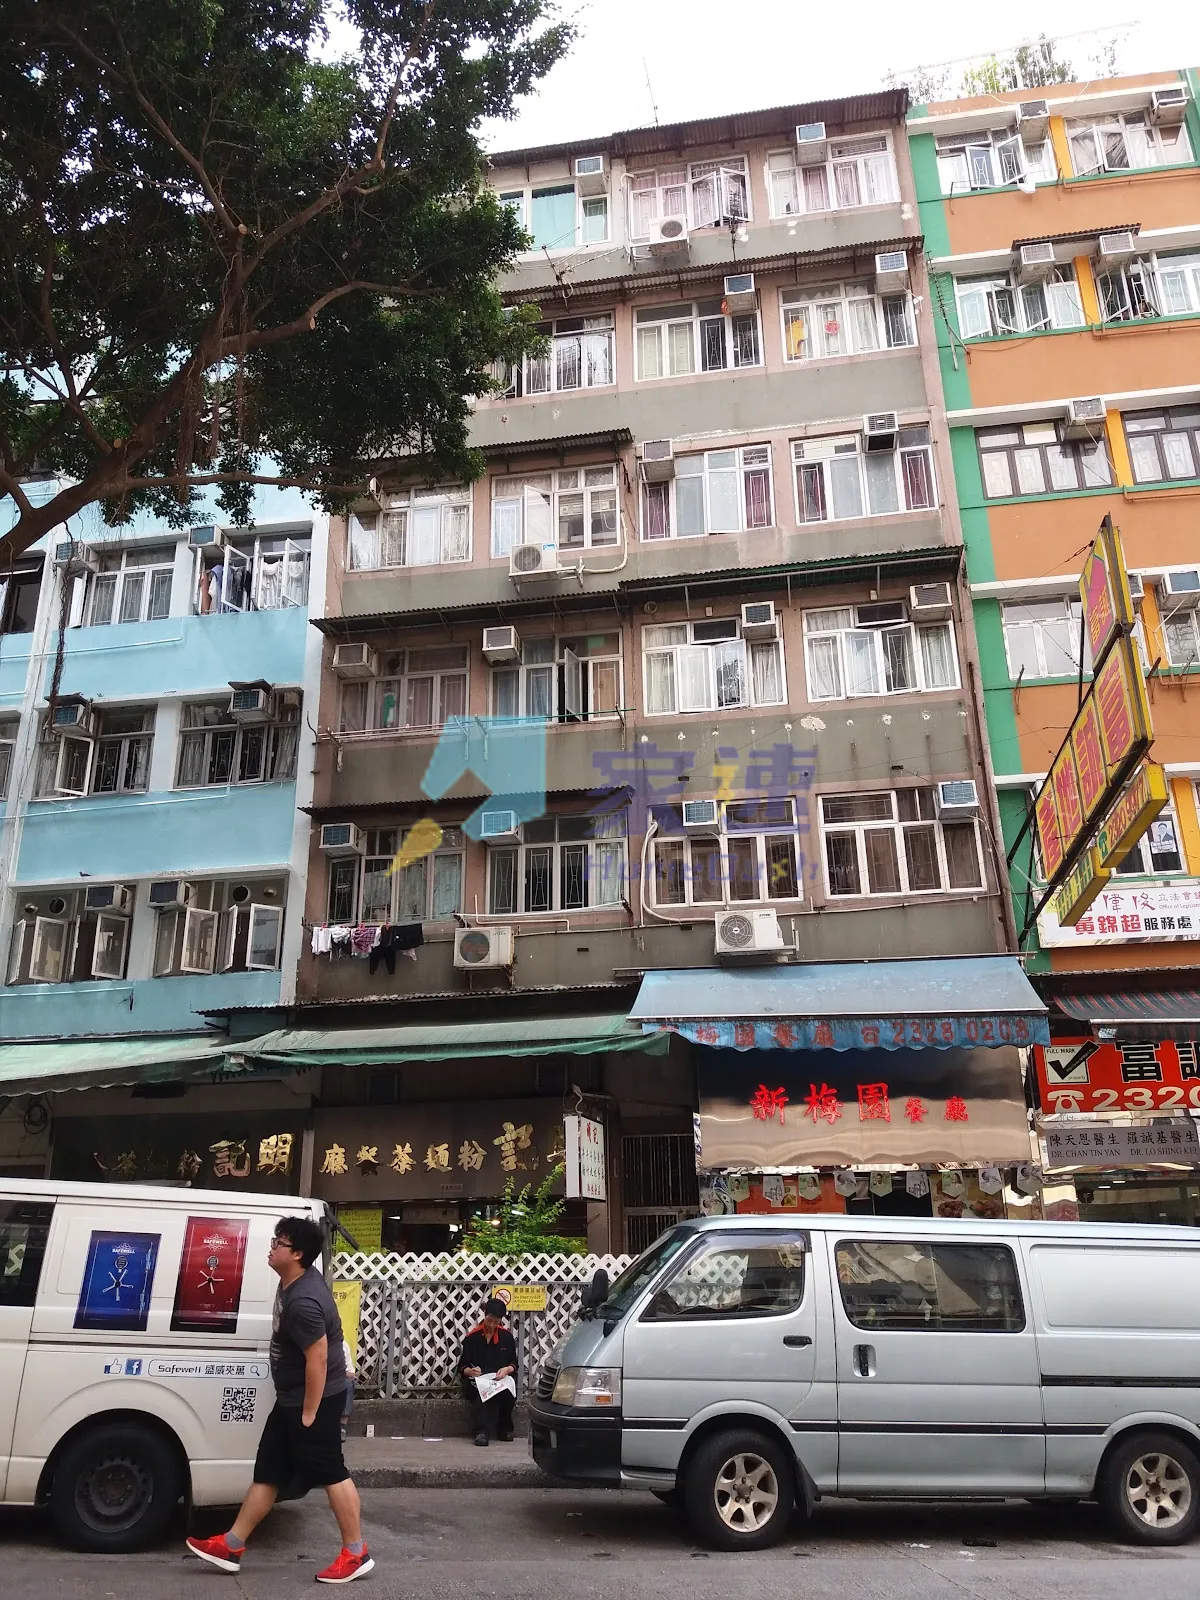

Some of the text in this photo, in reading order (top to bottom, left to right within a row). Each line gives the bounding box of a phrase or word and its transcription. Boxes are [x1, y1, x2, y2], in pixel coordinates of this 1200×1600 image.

[1085, 892, 1156, 912] 偉俊
[892, 1019, 1029, 1044] 2328 0208
[1049, 1130, 1198, 1146] 陳天恩醫生 羅誠基醫生
[1051, 1146, 1197, 1158] DR. CHAN TIN YAN DR. LO SHING KEI
[158, 1364, 245, 1375] Safewell 盛威夾萬
